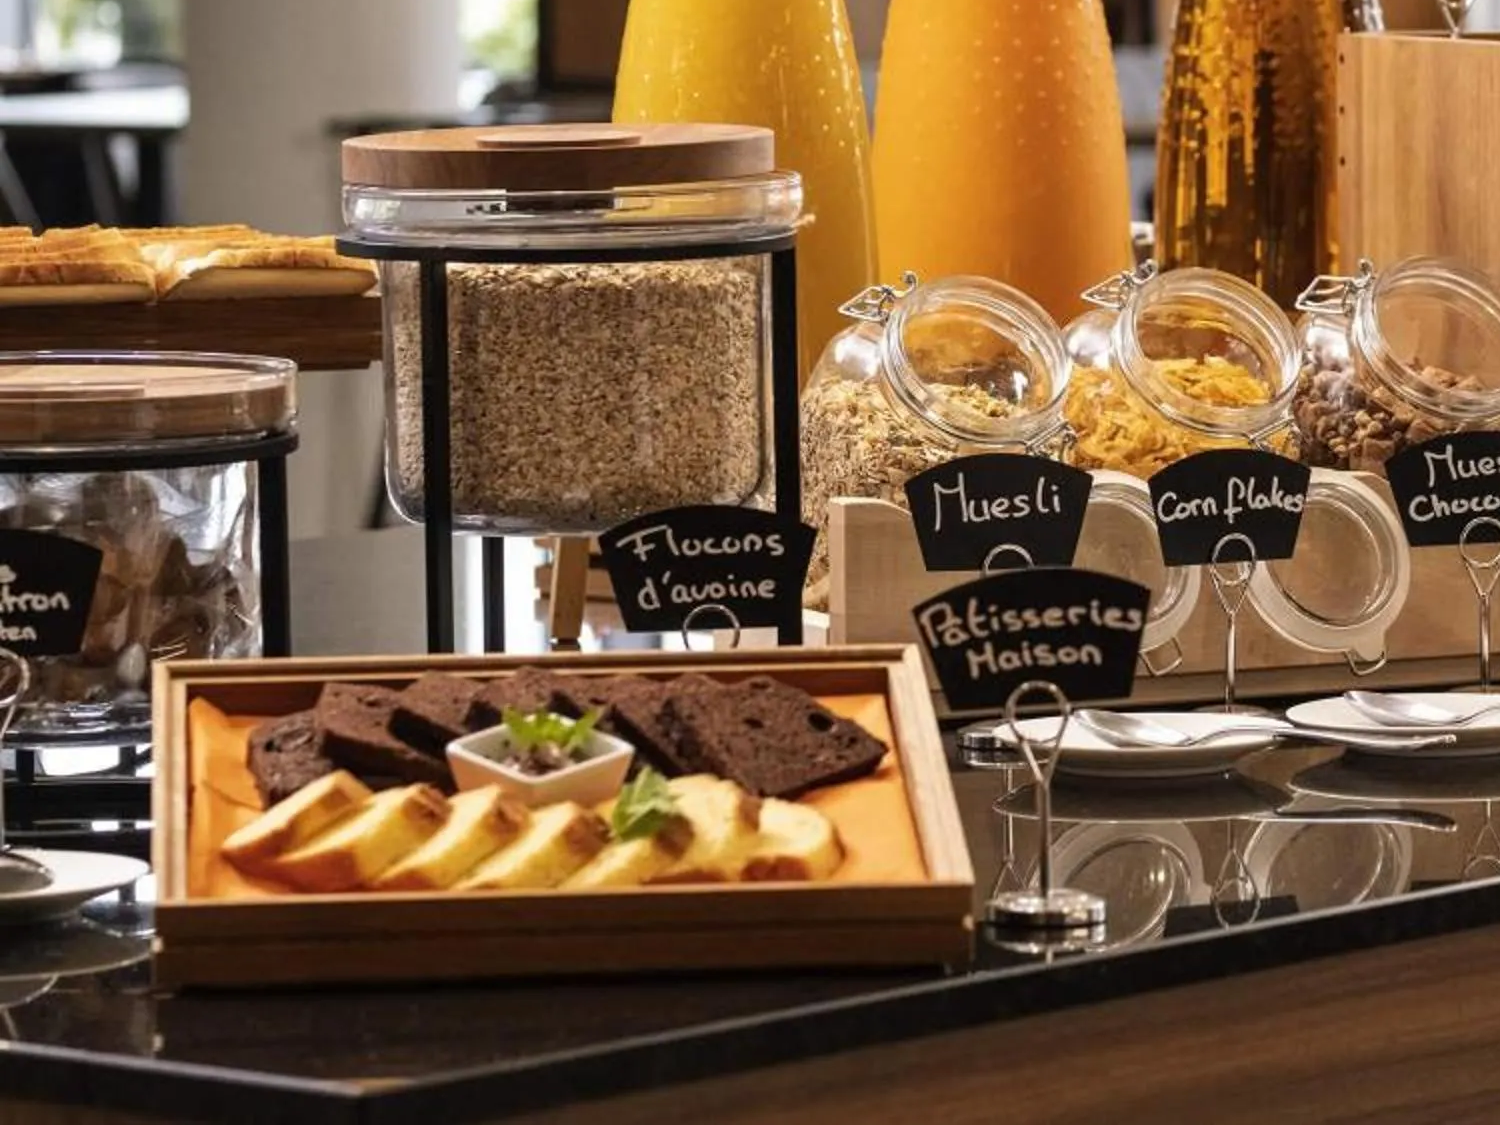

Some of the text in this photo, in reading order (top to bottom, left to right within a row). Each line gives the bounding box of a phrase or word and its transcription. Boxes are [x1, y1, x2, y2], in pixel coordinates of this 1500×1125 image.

[934, 472, 1061, 532] Muesli
[1157, 476, 1305, 524] Corn flakes
[616, 524, 785, 561] Flocons
[0, 584, 70, 613] tron
[637, 571, 776, 610] d'avoine
[966, 641, 1103, 679] Maison
